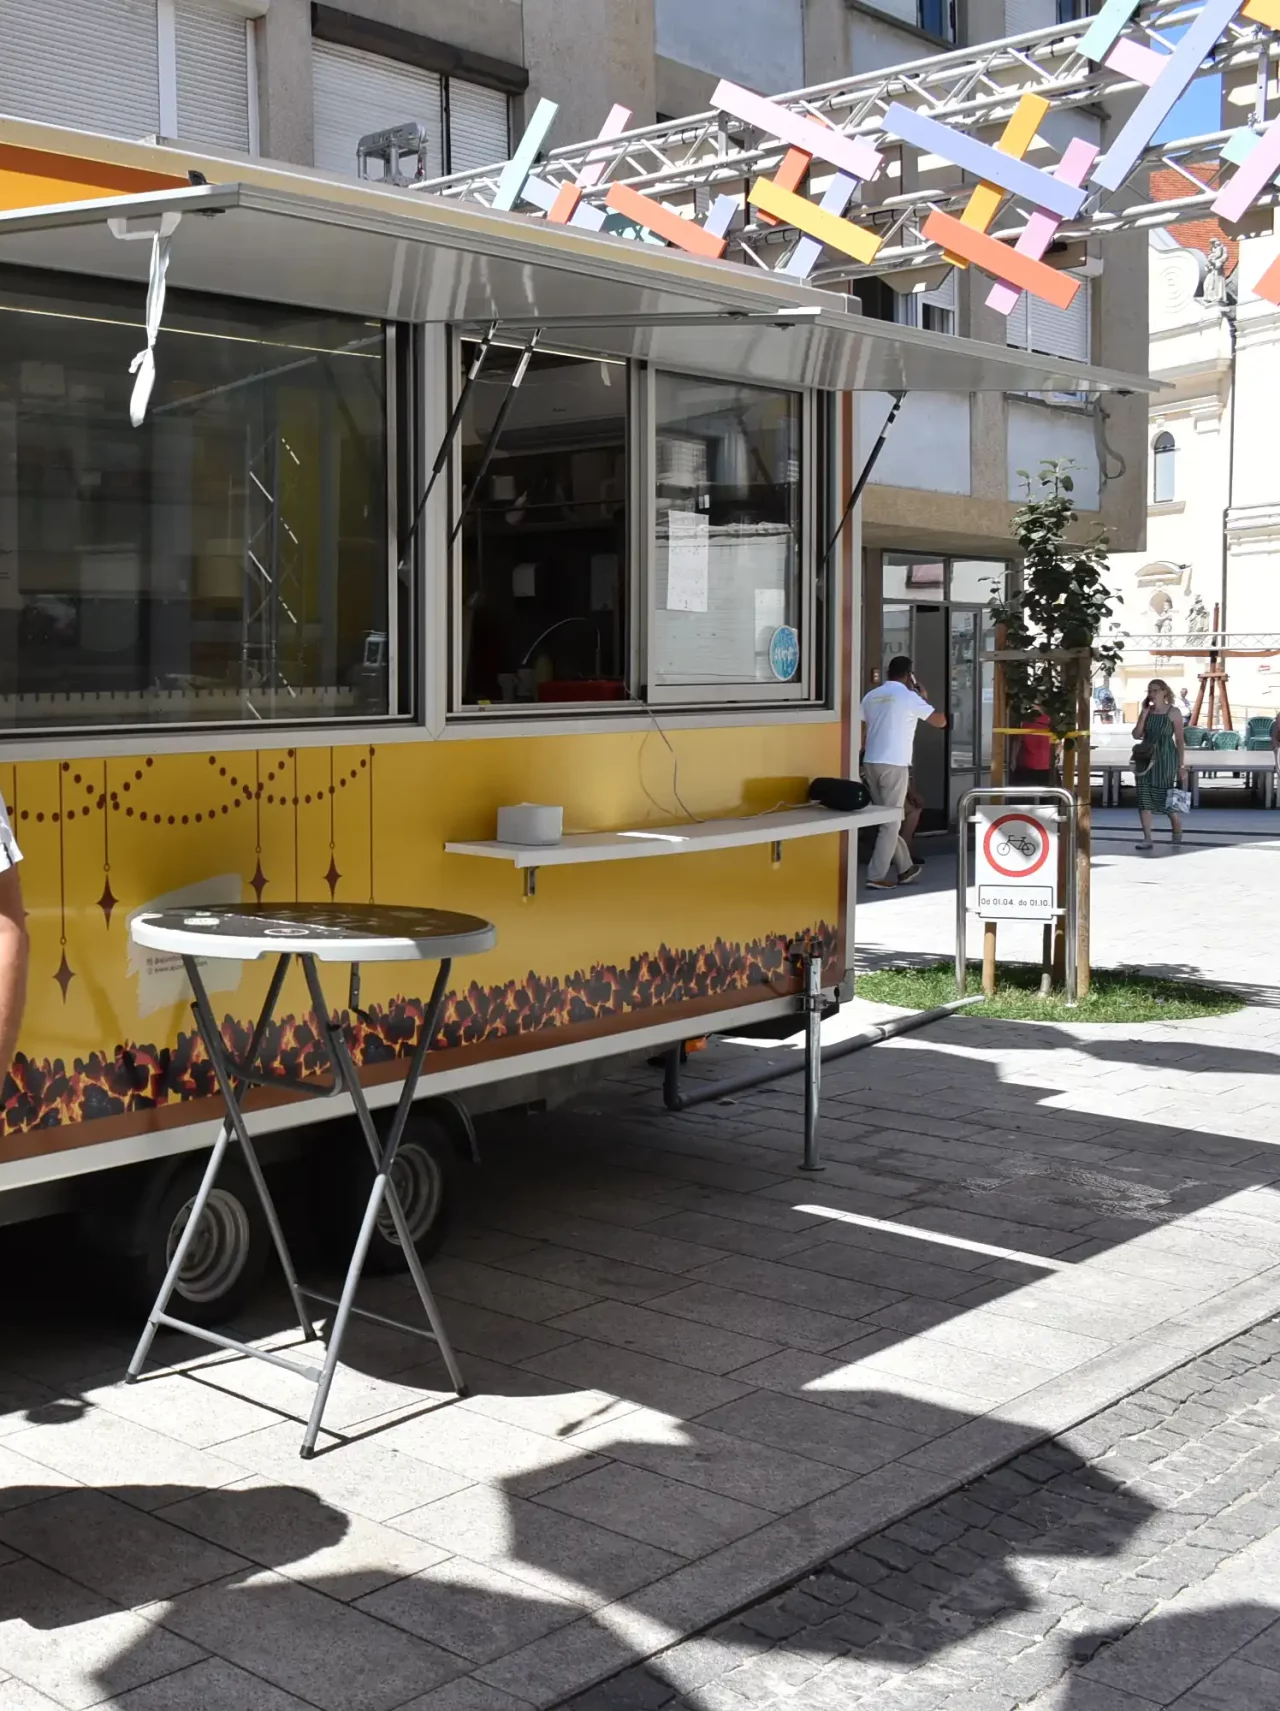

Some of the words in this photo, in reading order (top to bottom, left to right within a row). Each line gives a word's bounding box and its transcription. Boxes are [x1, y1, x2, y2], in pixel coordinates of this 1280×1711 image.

[993, 898, 1016, 906] 01.04.
[1018, 898, 1027, 906] do
[1030, 899, 1051, 907] 01.10.
